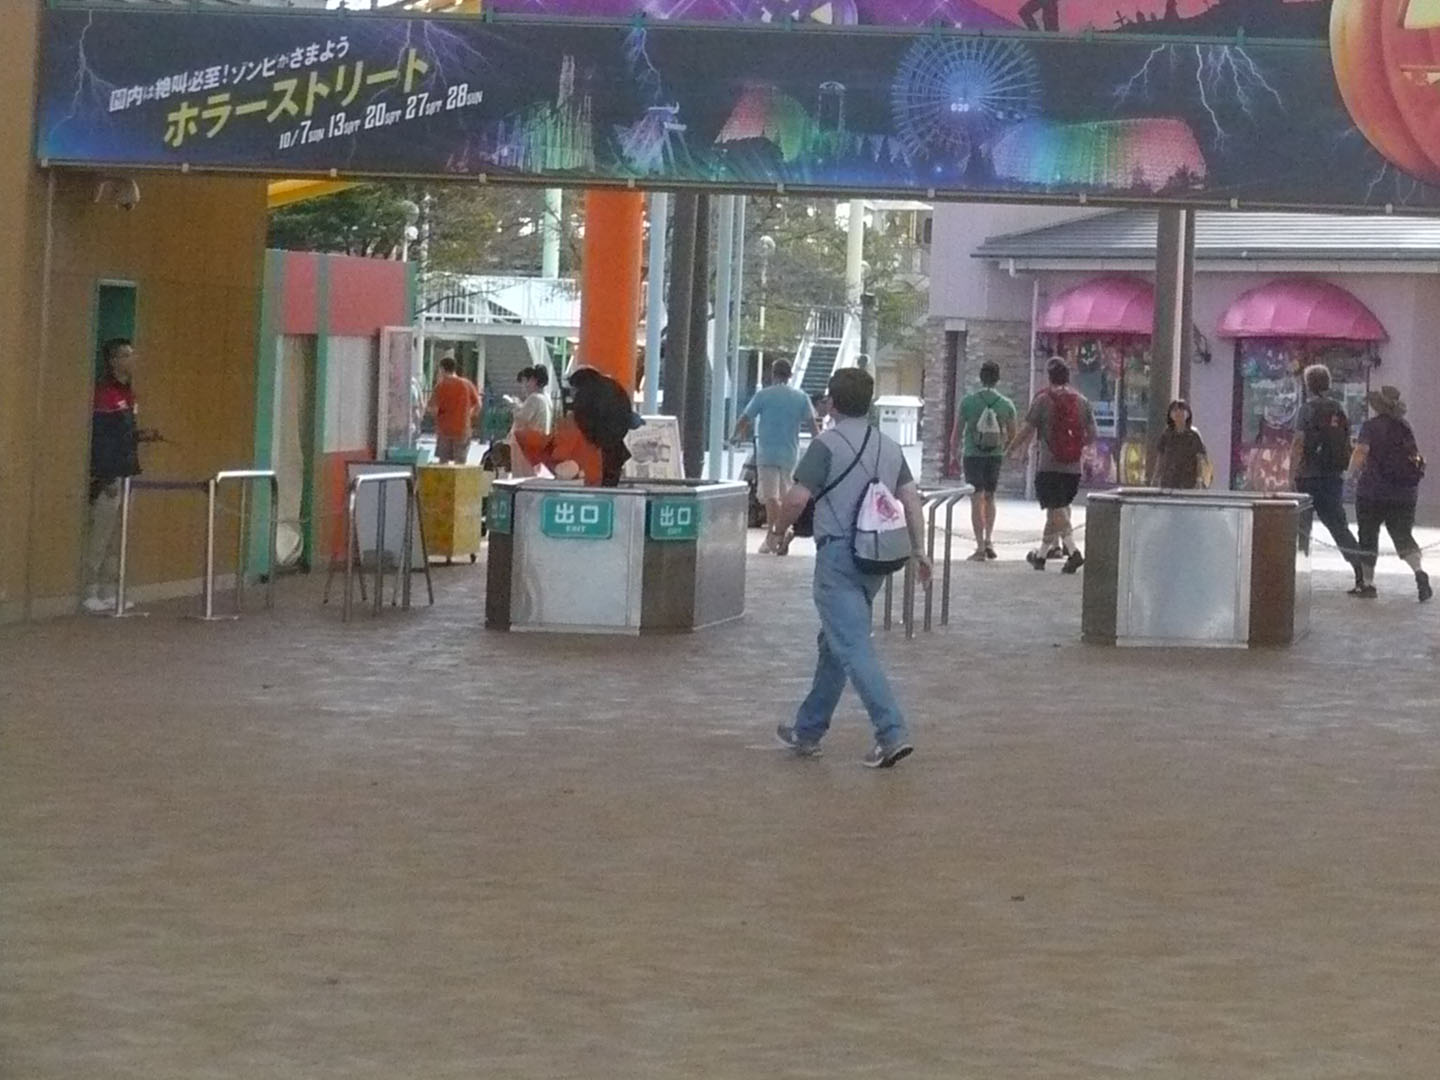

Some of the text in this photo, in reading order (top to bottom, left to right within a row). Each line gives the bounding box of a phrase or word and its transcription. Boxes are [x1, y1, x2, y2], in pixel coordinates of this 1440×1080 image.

[164, 47, 429, 147] ホラーストリート
[554, 502, 600, 524] 出口
[659, 505, 691, 527] 出口
